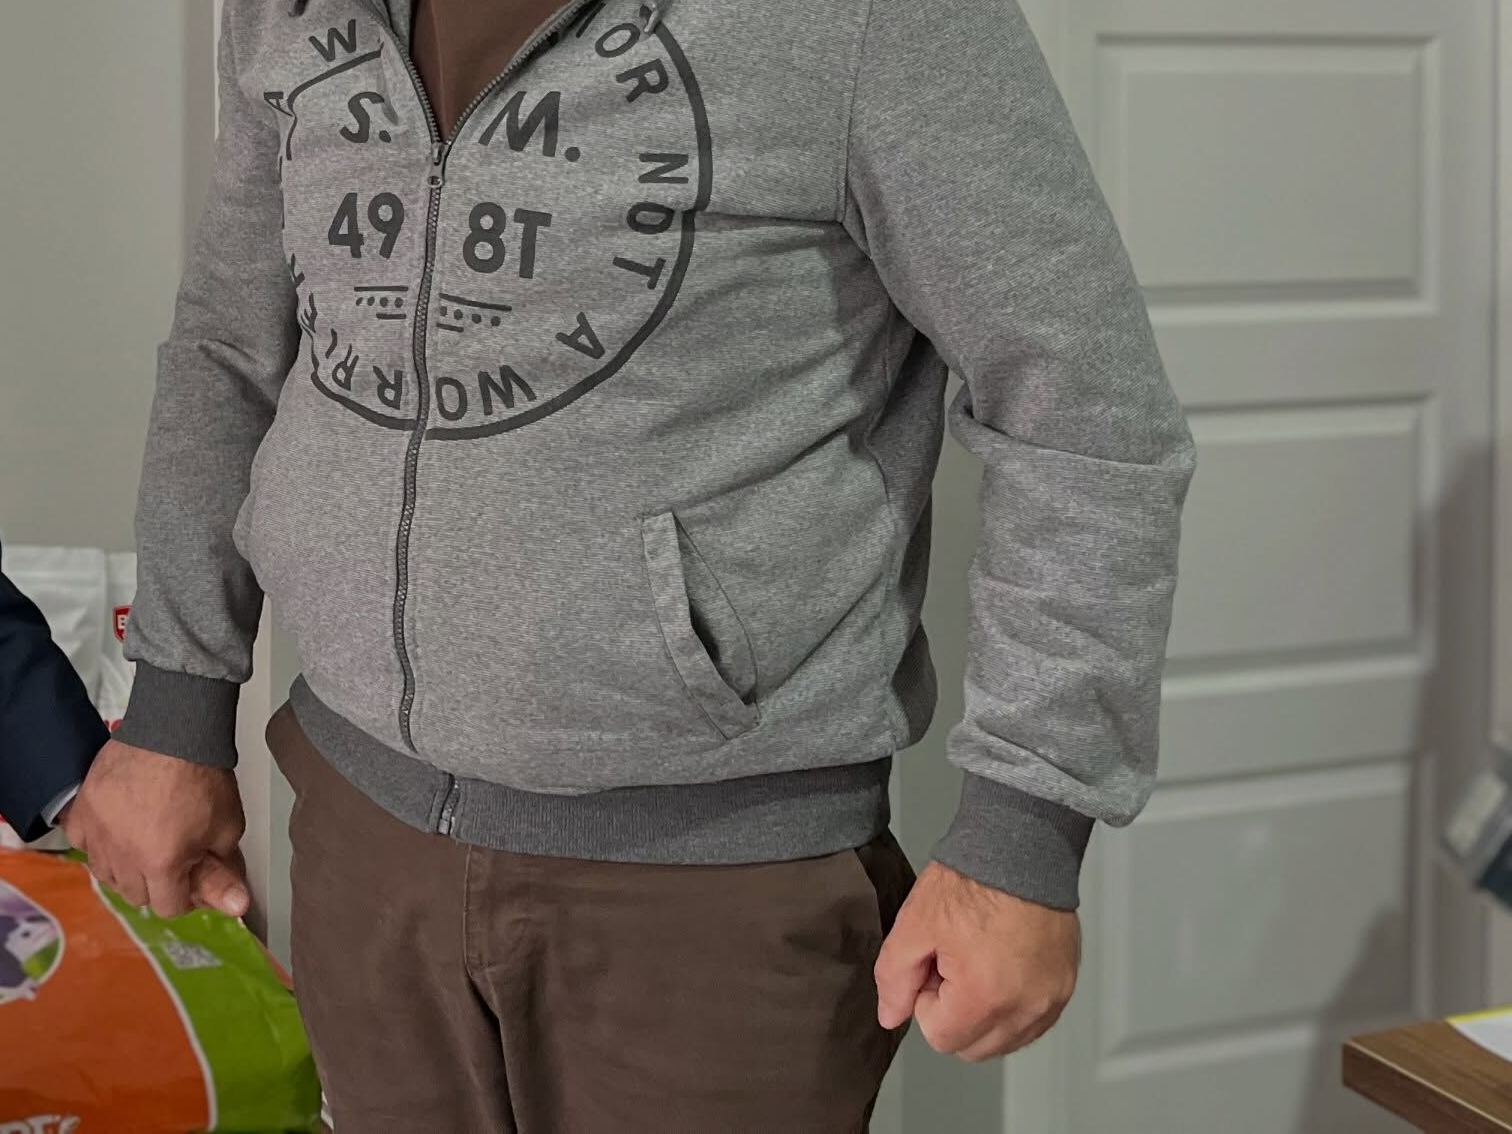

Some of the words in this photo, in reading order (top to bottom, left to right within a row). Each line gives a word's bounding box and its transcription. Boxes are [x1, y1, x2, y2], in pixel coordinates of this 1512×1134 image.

[327, 191, 406, 260] 49
[462, 201, 553, 280] 8T
[611, 152, 690, 290] NOT
